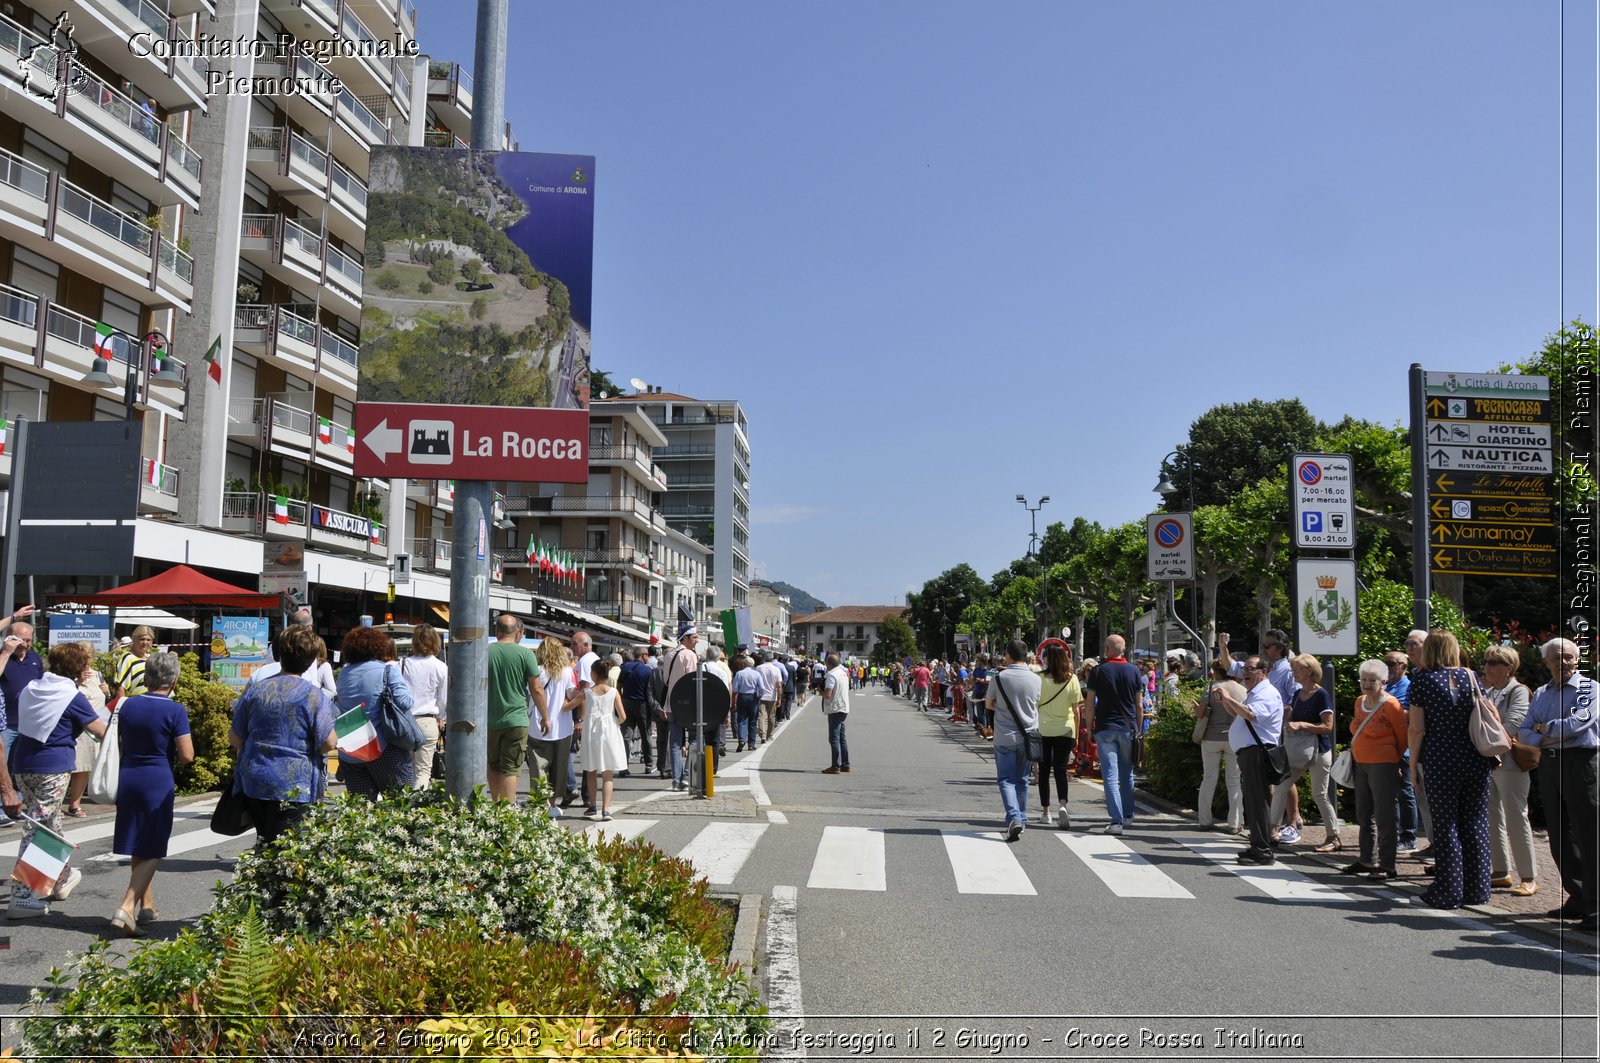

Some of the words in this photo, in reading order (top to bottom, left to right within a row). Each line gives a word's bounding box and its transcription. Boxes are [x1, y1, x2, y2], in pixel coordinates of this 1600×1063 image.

[528, 185, 554, 193] Comune
[556, 185, 563, 194] di
[563, 186, 587, 195] ARONA
[1465, 378, 1490, 388] Città
[1493, 379, 1503, 389] di
[1507, 380, 1538, 390] Arona
[1474, 399, 1542, 415] TECNOCASA
[1484, 414, 1534, 422] AFFILIATO
[1488, 425, 1535, 435] HOTEL
[463, 429, 493, 458] La
[502, 431, 582, 461] Rocca
[1476, 435, 1547, 446] GIARDINO
[1462, 449, 1543, 463] NAUTICA
[1306, 513, 1319, 530] P
[223, 620, 258, 630] ARONA
[57, 631, 102, 639] COMUNICAZIONE
